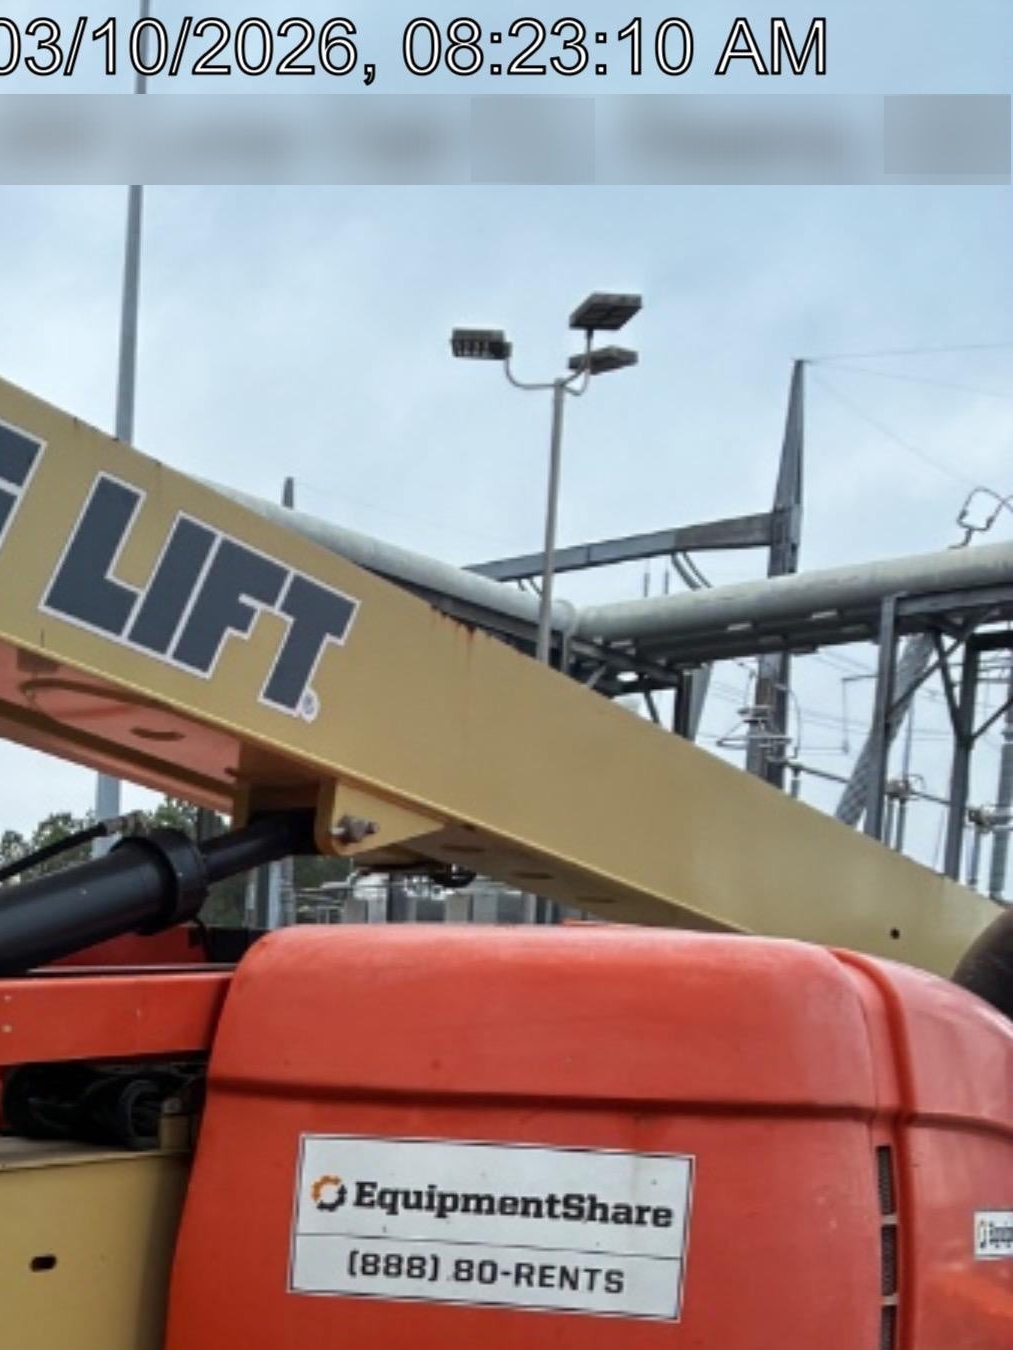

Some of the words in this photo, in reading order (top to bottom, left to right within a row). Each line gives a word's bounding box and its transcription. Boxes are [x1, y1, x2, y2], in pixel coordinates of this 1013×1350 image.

[353, 1180, 673, 1228] EquipmentShare
[348, 1250, 439, 1282] (888)
[453, 1258, 625, 1294] 80-RENTS
